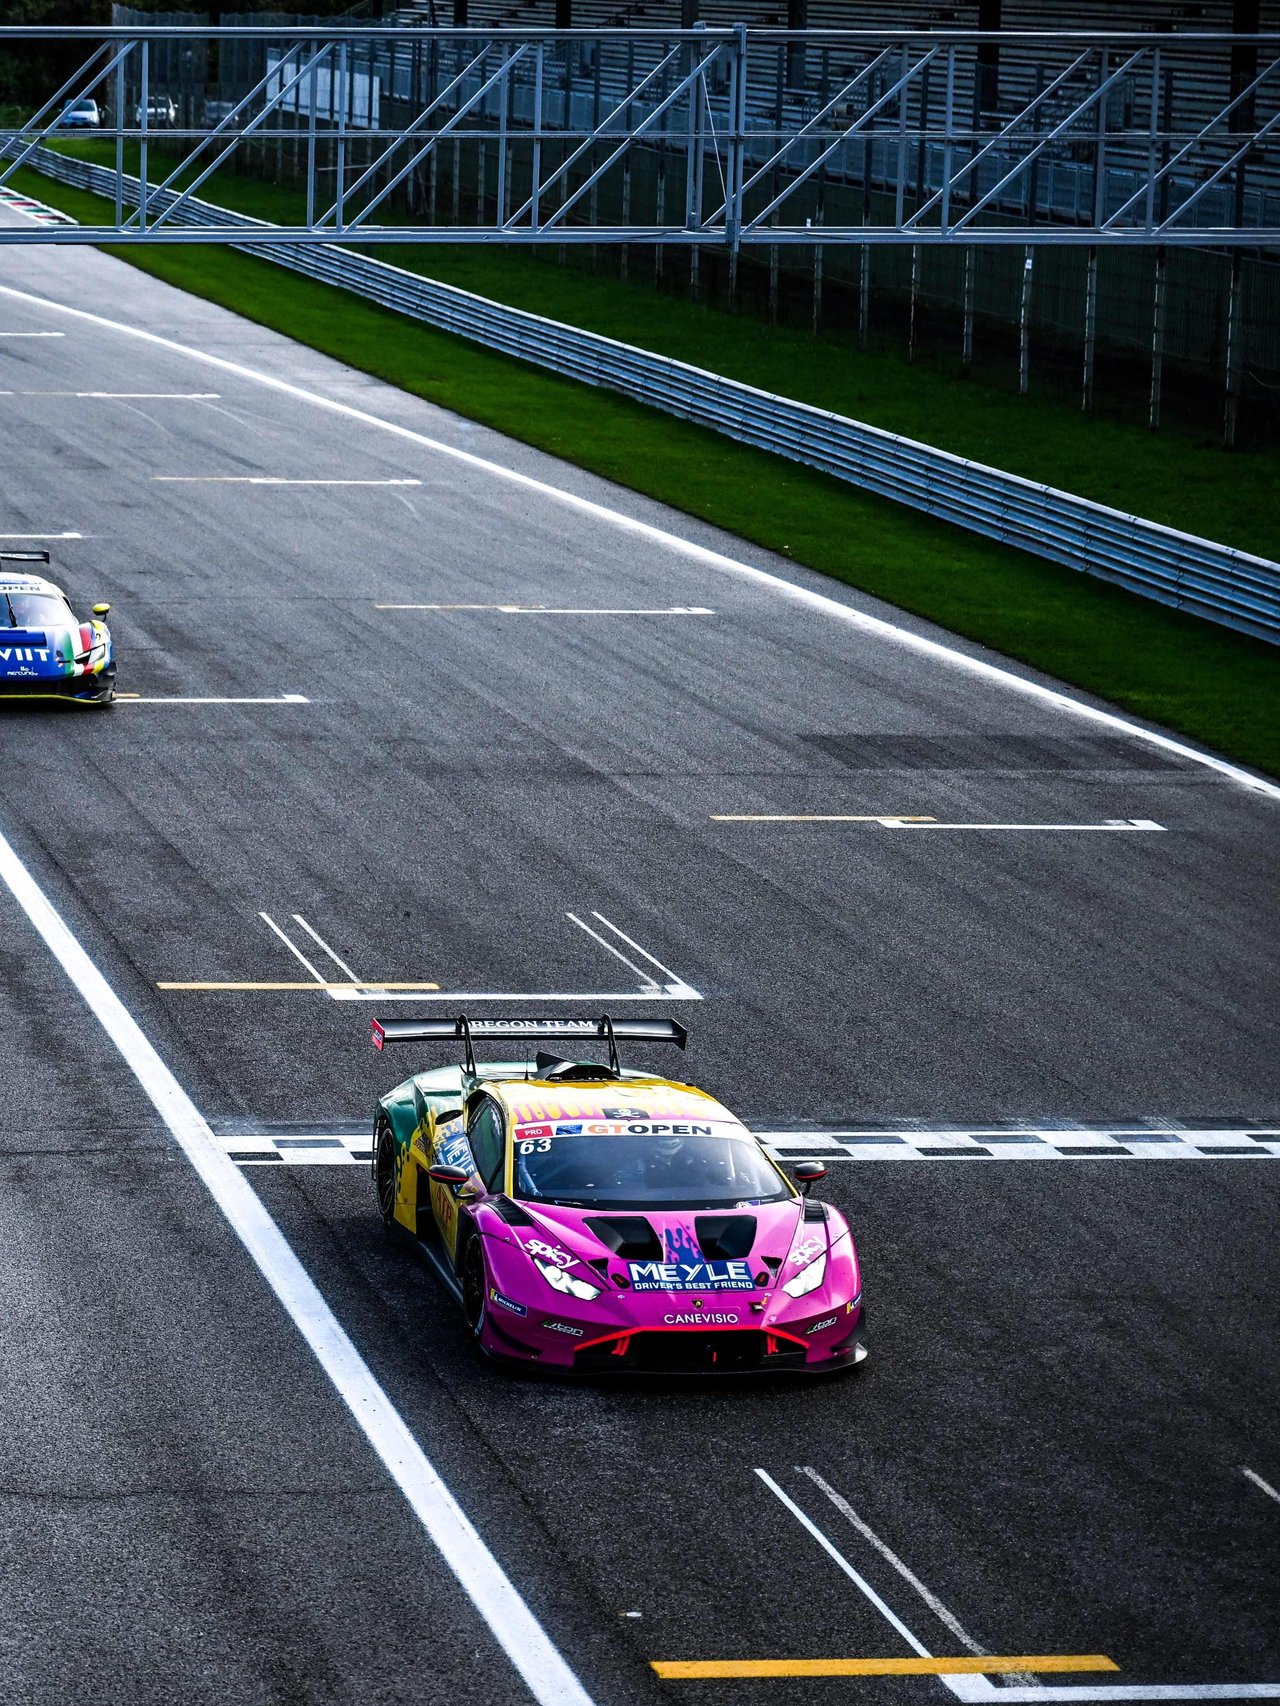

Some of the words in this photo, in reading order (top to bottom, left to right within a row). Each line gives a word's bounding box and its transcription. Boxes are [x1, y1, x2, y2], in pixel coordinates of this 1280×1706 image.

[542, 1020, 595, 1028] TEAM
[520, 1138, 551, 1155] 63
[524, 1239, 581, 1269] spicy
[629, 1262, 751, 1281] MEYLE
[634, 1282, 683, 1290] DRIVER'S
[714, 1281, 754, 1289] FRIEND
[664, 1313, 739, 1324] CANEVISIO
